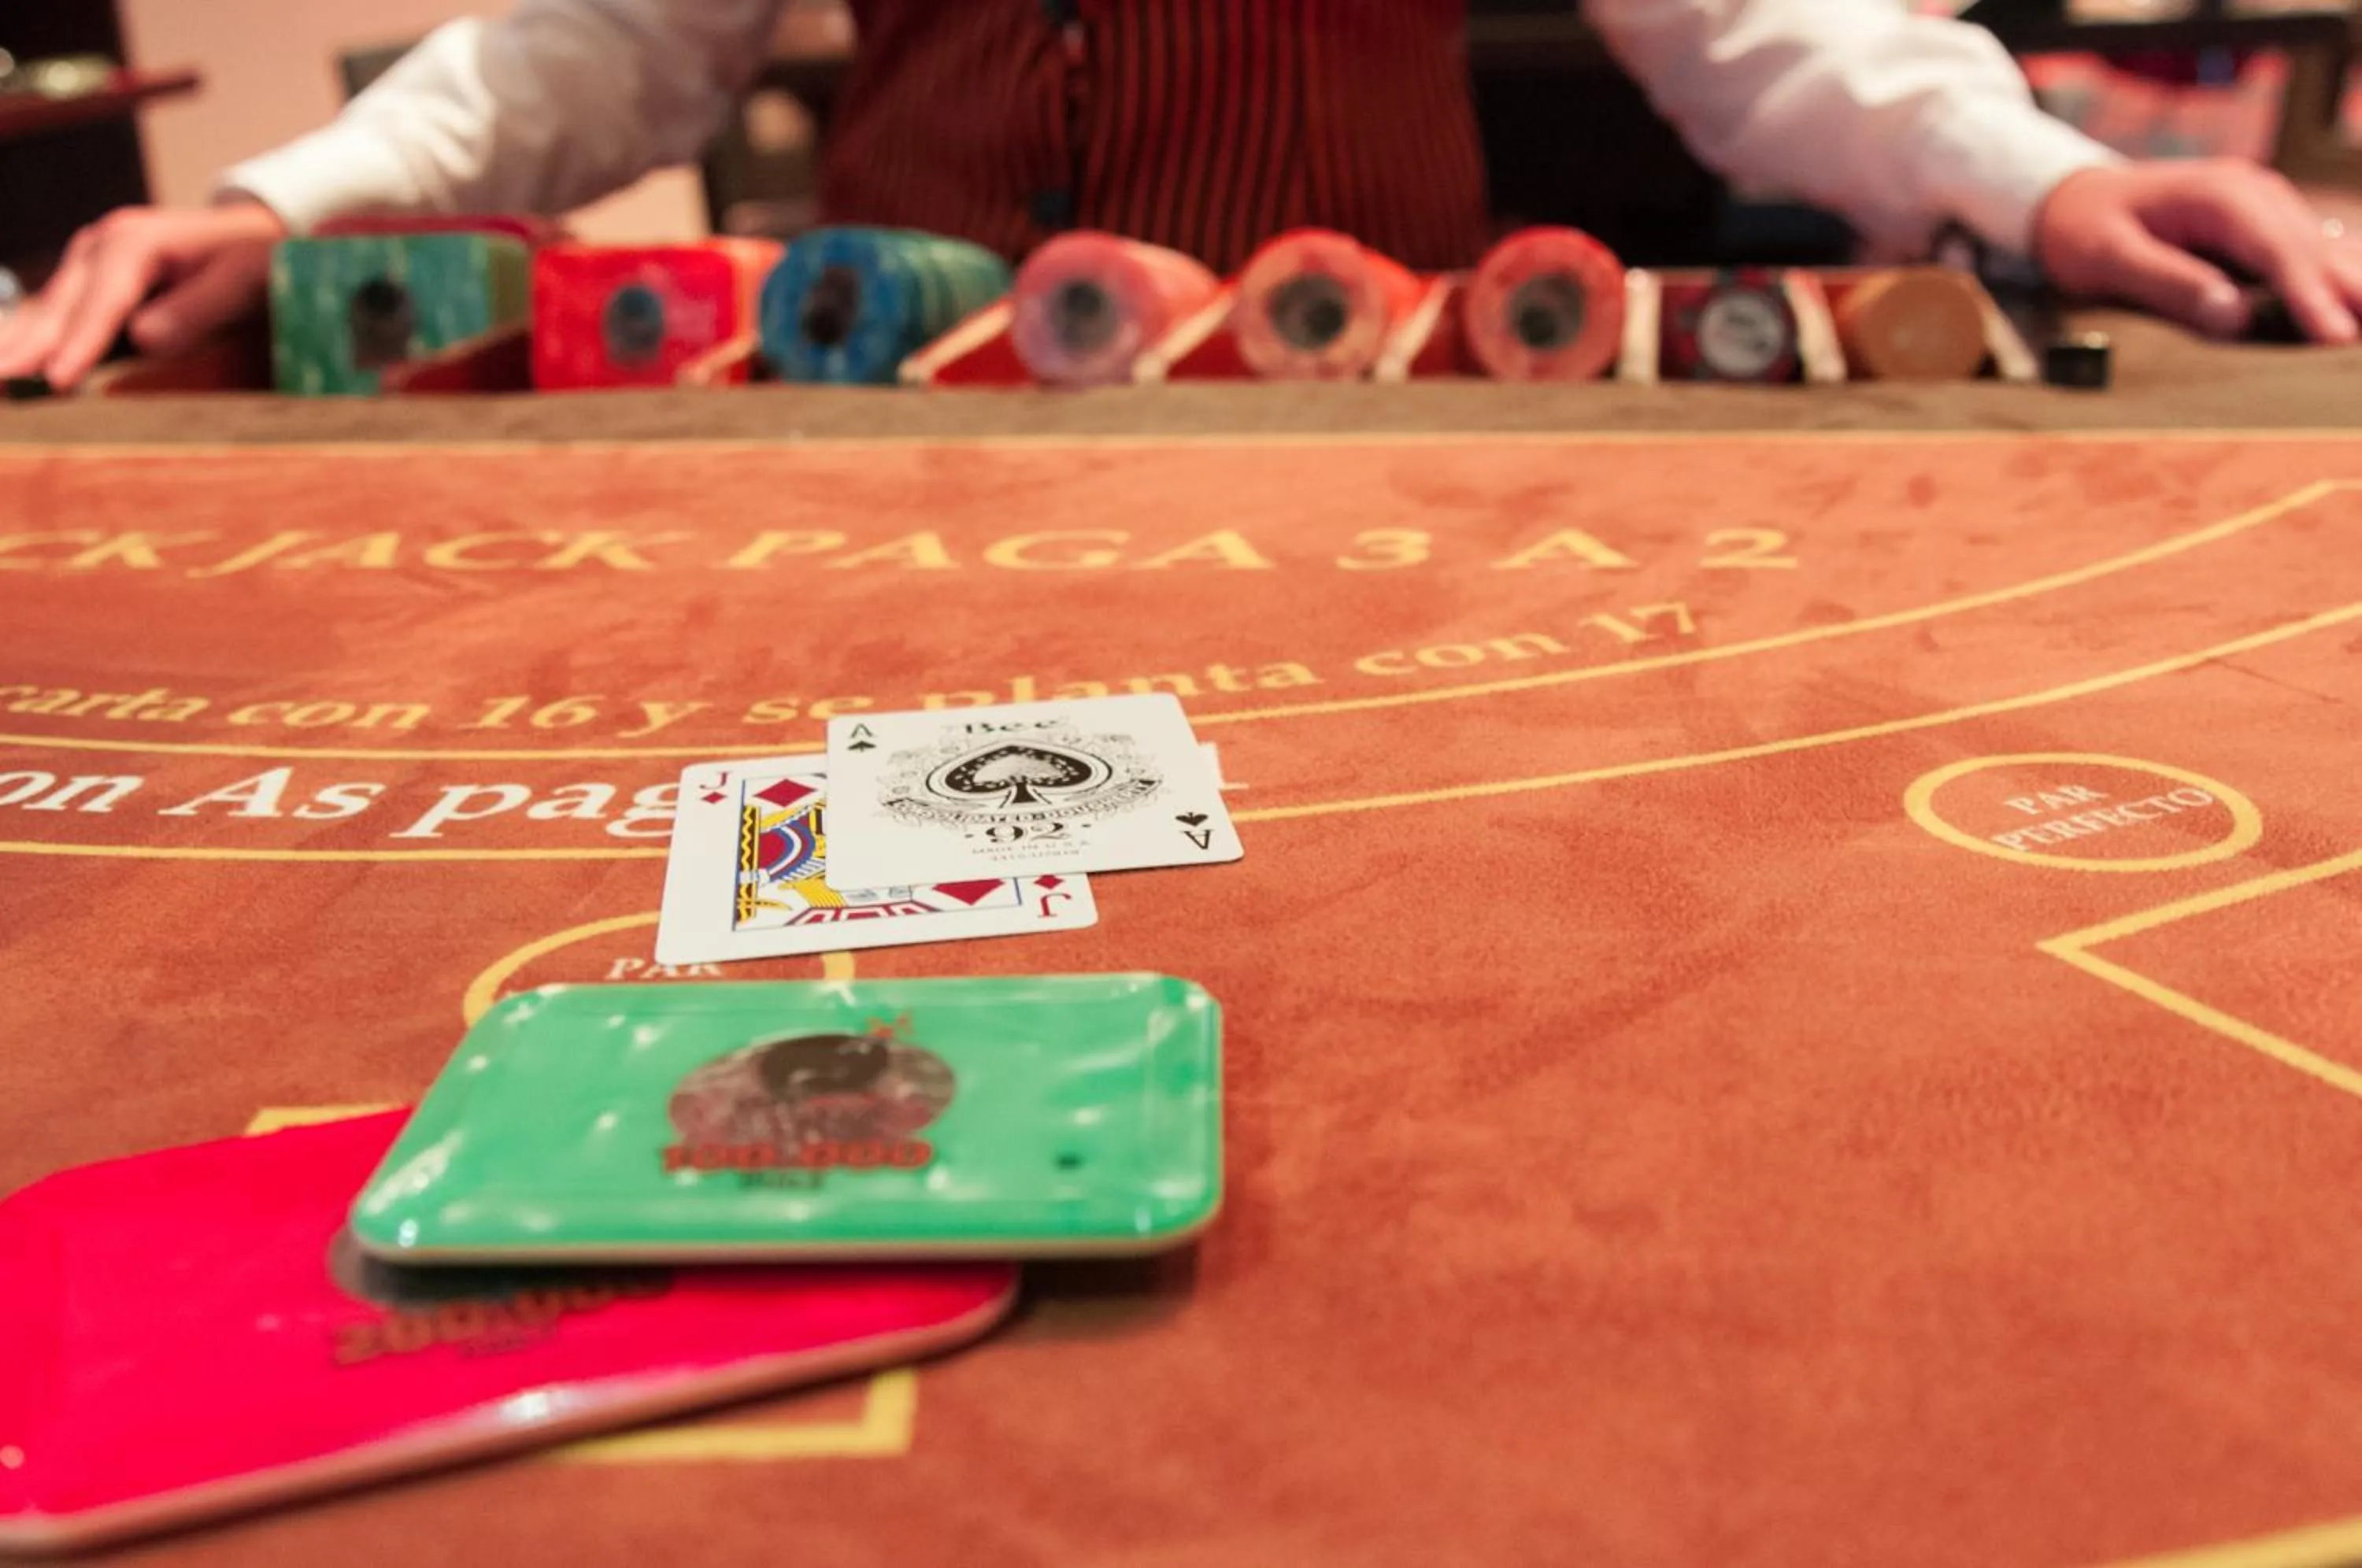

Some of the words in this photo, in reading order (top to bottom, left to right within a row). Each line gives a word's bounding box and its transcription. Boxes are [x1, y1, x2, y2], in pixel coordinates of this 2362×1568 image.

[186, 530, 696, 579] JACK
[716, 530, 1274, 570] PAGA
[1336, 529, 1431, 570] 3
[1490, 529, 1639, 569] A
[1699, 529, 1798, 569] 2
[228, 697, 431, 729] con
[459, 694, 605, 729] 16
[618, 698, 713, 738] y
[742, 695, 875, 723] se
[1353, 630, 1568, 677] con
[1579, 601, 1699, 644] 17
[849, 723, 878, 738] A
[157, 767, 387, 818] As
[698, 770, 734, 790] J
[2003, 784, 2110, 816] PAR
[985, 820, 1072, 843] 92
[1990, 787, 2214, 852] PERFECTO
[1179, 829, 1214, 850] A
[1037, 891, 1072, 919] J
